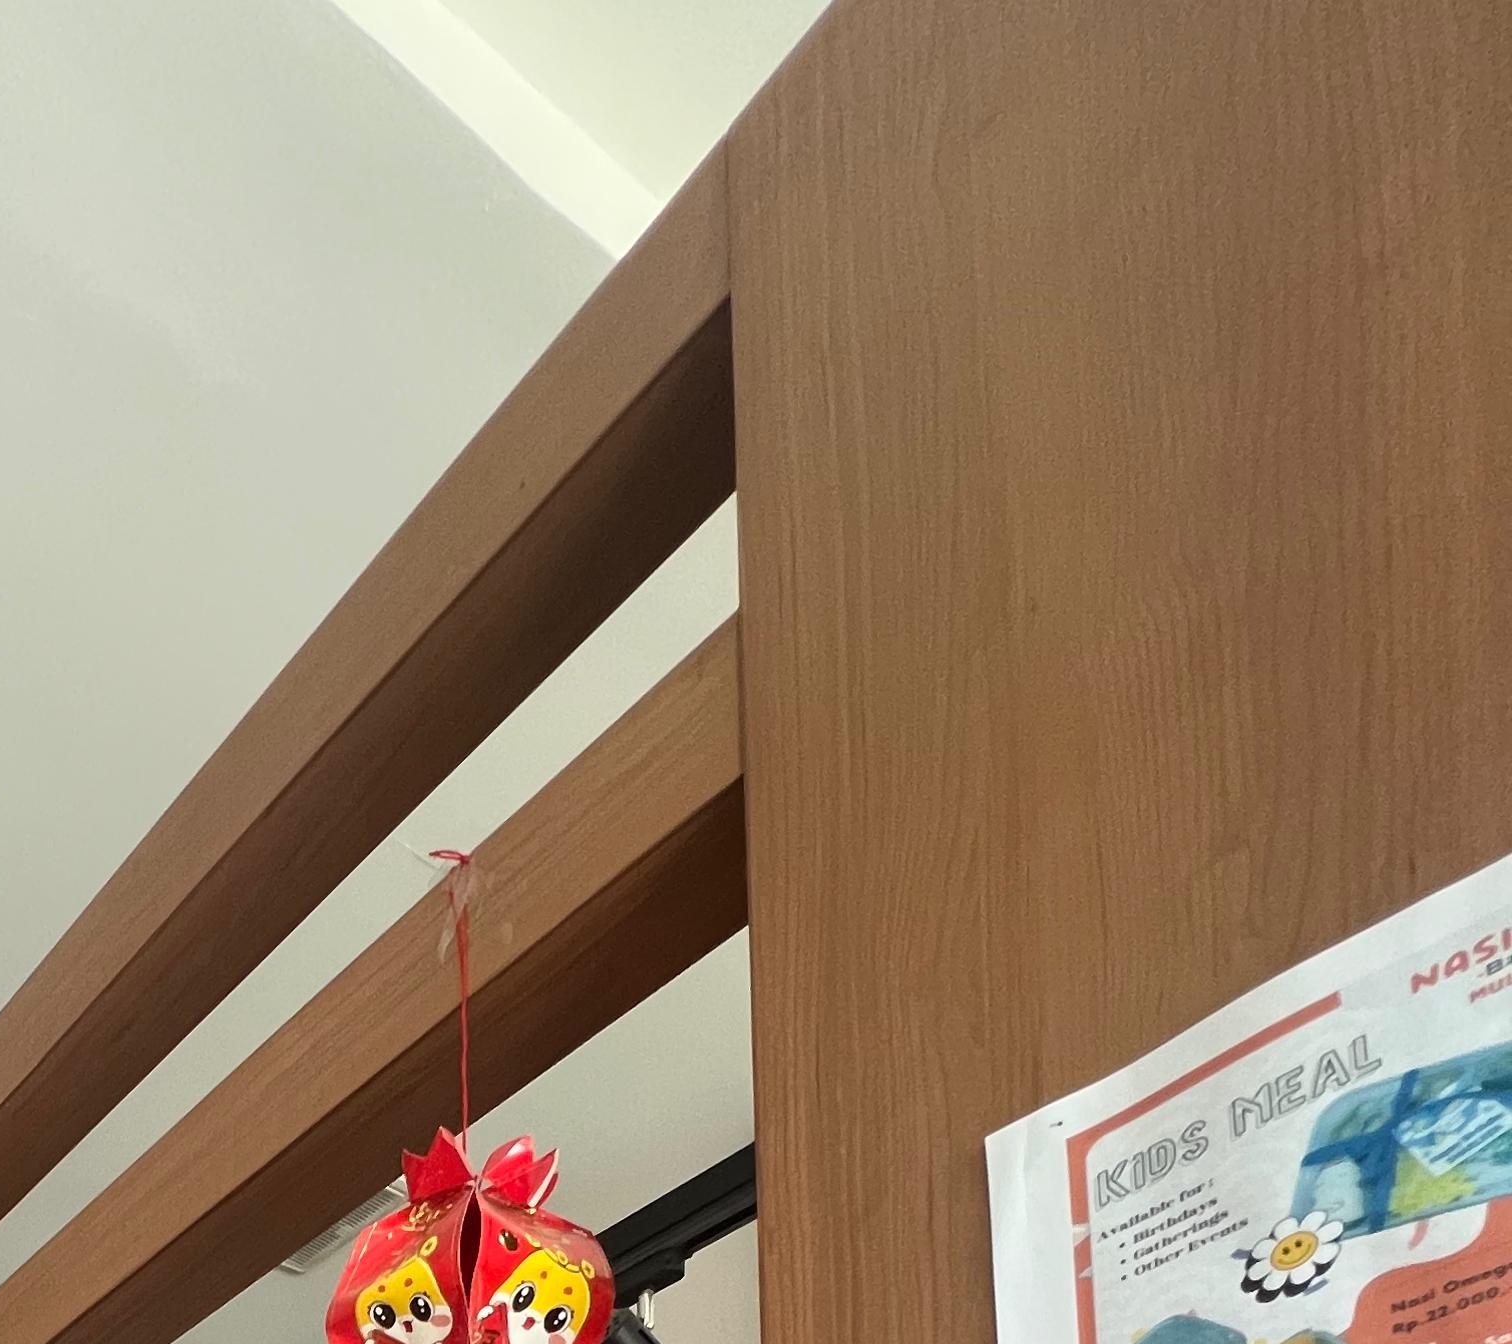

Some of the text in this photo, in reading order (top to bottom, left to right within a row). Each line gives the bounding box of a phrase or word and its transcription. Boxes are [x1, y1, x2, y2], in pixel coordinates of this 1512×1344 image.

[1095, 1035, 1383, 1213] KIDS MEAL
[1096, 1200, 1175, 1244] Available
[1133, 1197, 1218, 1245] Birthdays
[1133, 1210, 1229, 1261] Gatherings
[1134, 1217, 1249, 1277] Other Events
[1390, 1288, 1436, 1314] Nasi
